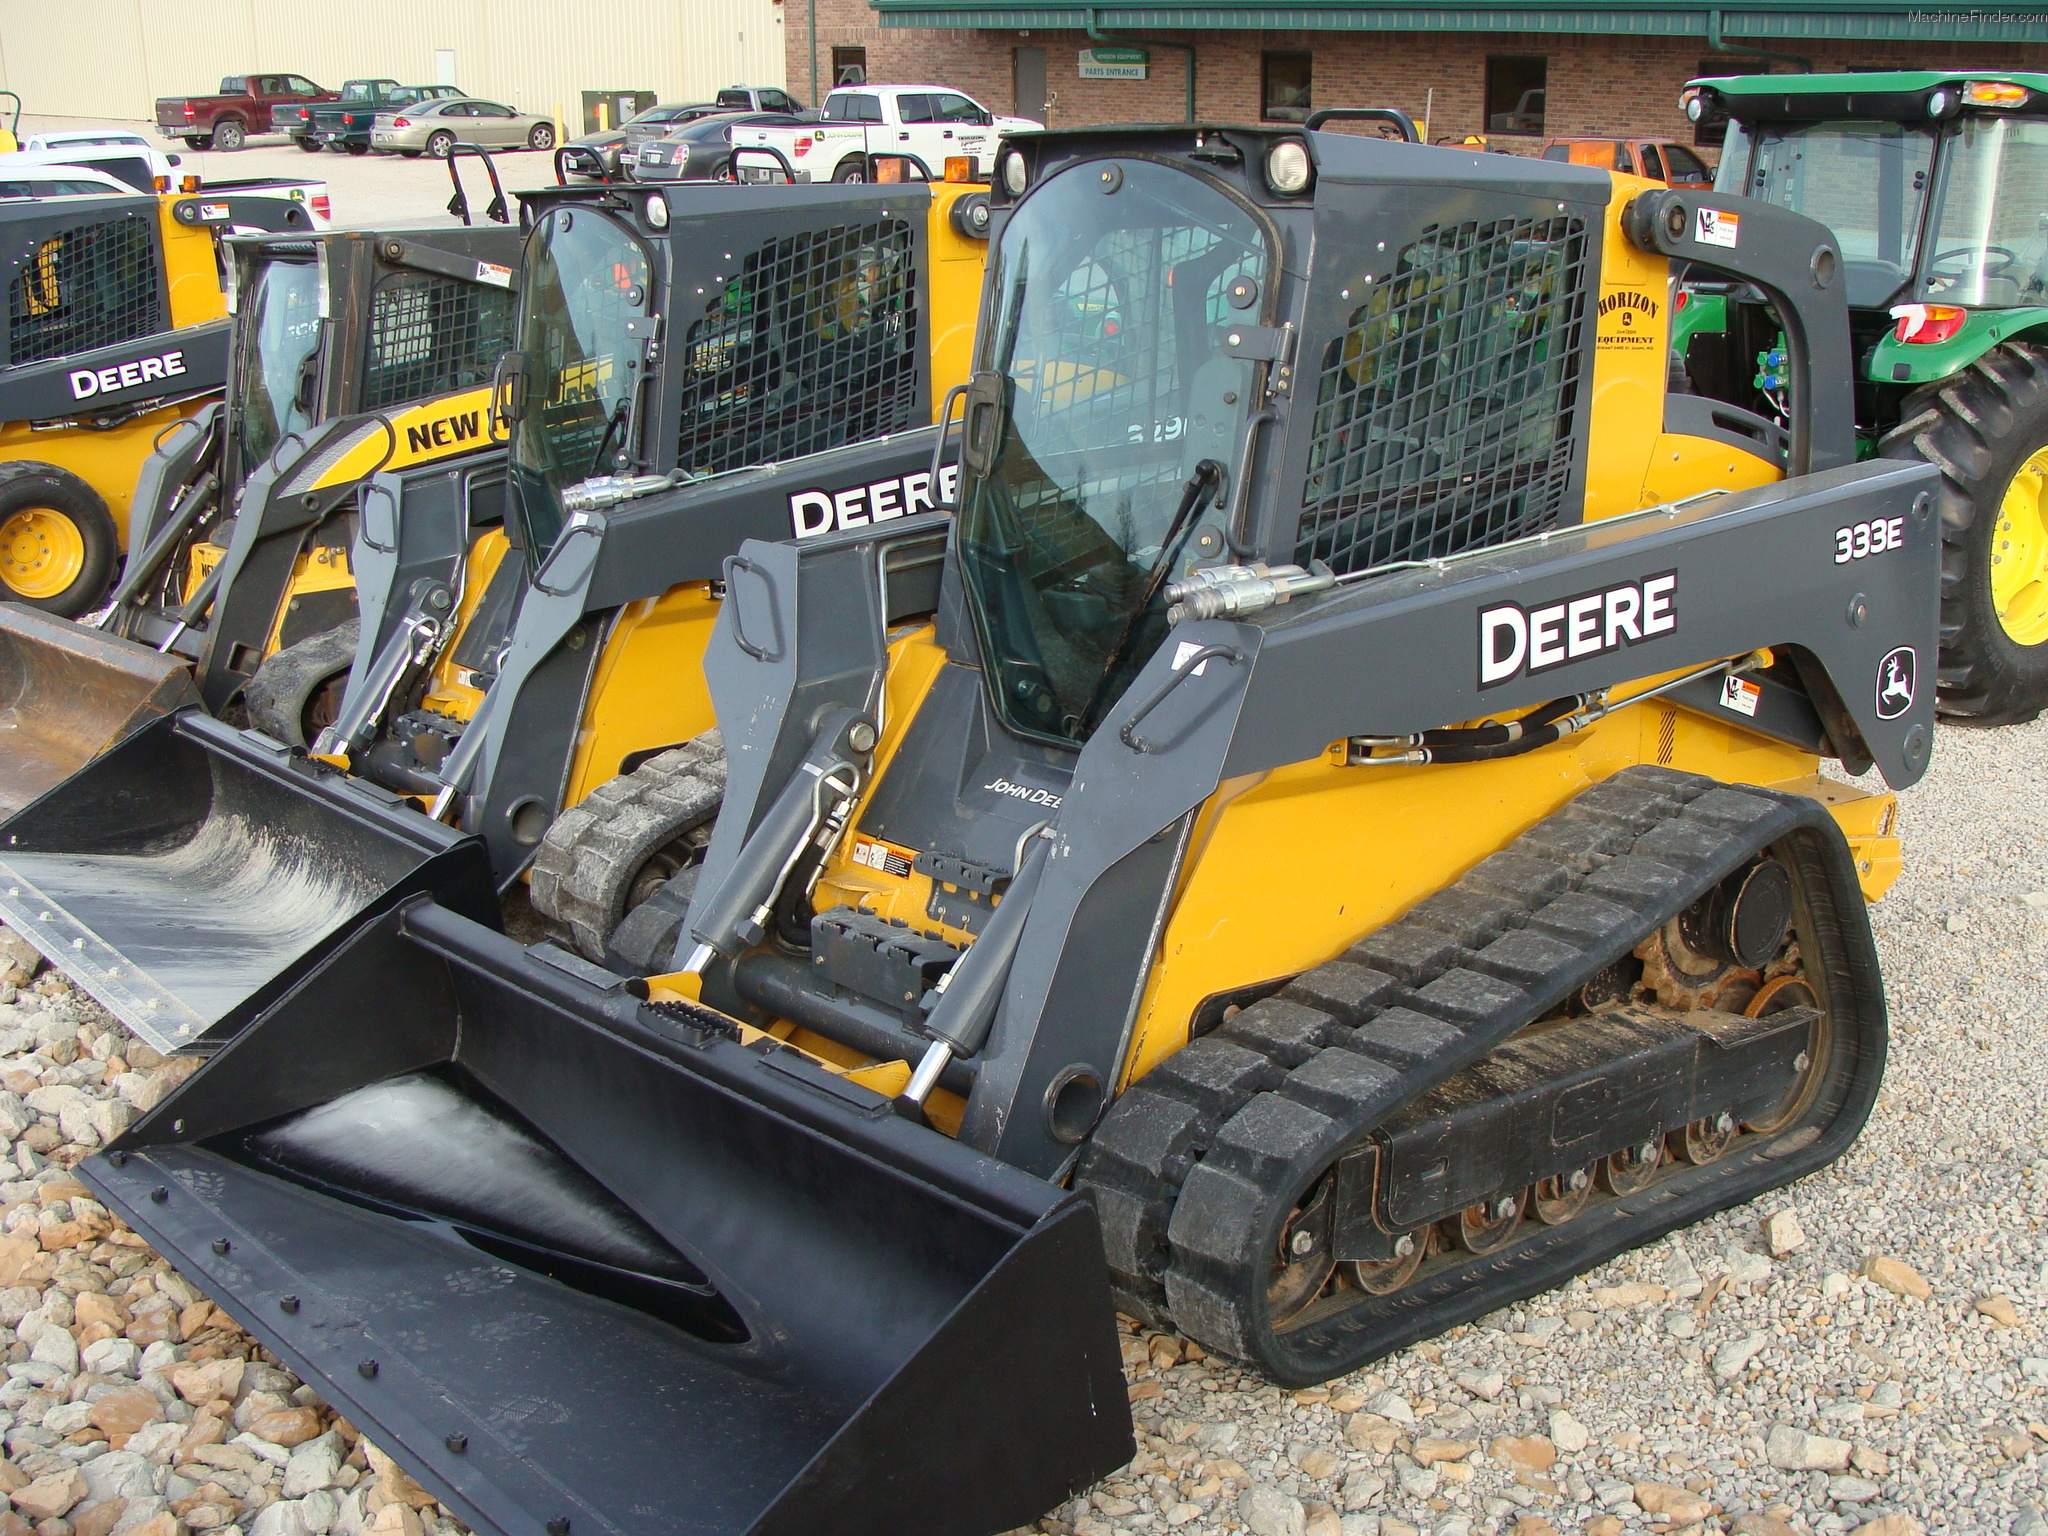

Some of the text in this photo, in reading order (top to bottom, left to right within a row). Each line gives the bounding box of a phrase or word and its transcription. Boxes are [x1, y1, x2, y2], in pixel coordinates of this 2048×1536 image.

[1085, 68, 1139, 76] PARTS ENTRANCE
[1598, 291, 1659, 319] HORIZON
[1597, 336, 1654, 345] EQUIPMENT
[69, 351, 187, 400] DEERE
[407, 411, 479, 454] NEW
[1835, 517, 1903, 564] 333E
[1482, 575, 1675, 683] DEERE
[984, 778, 1063, 809] JOHN DEE
